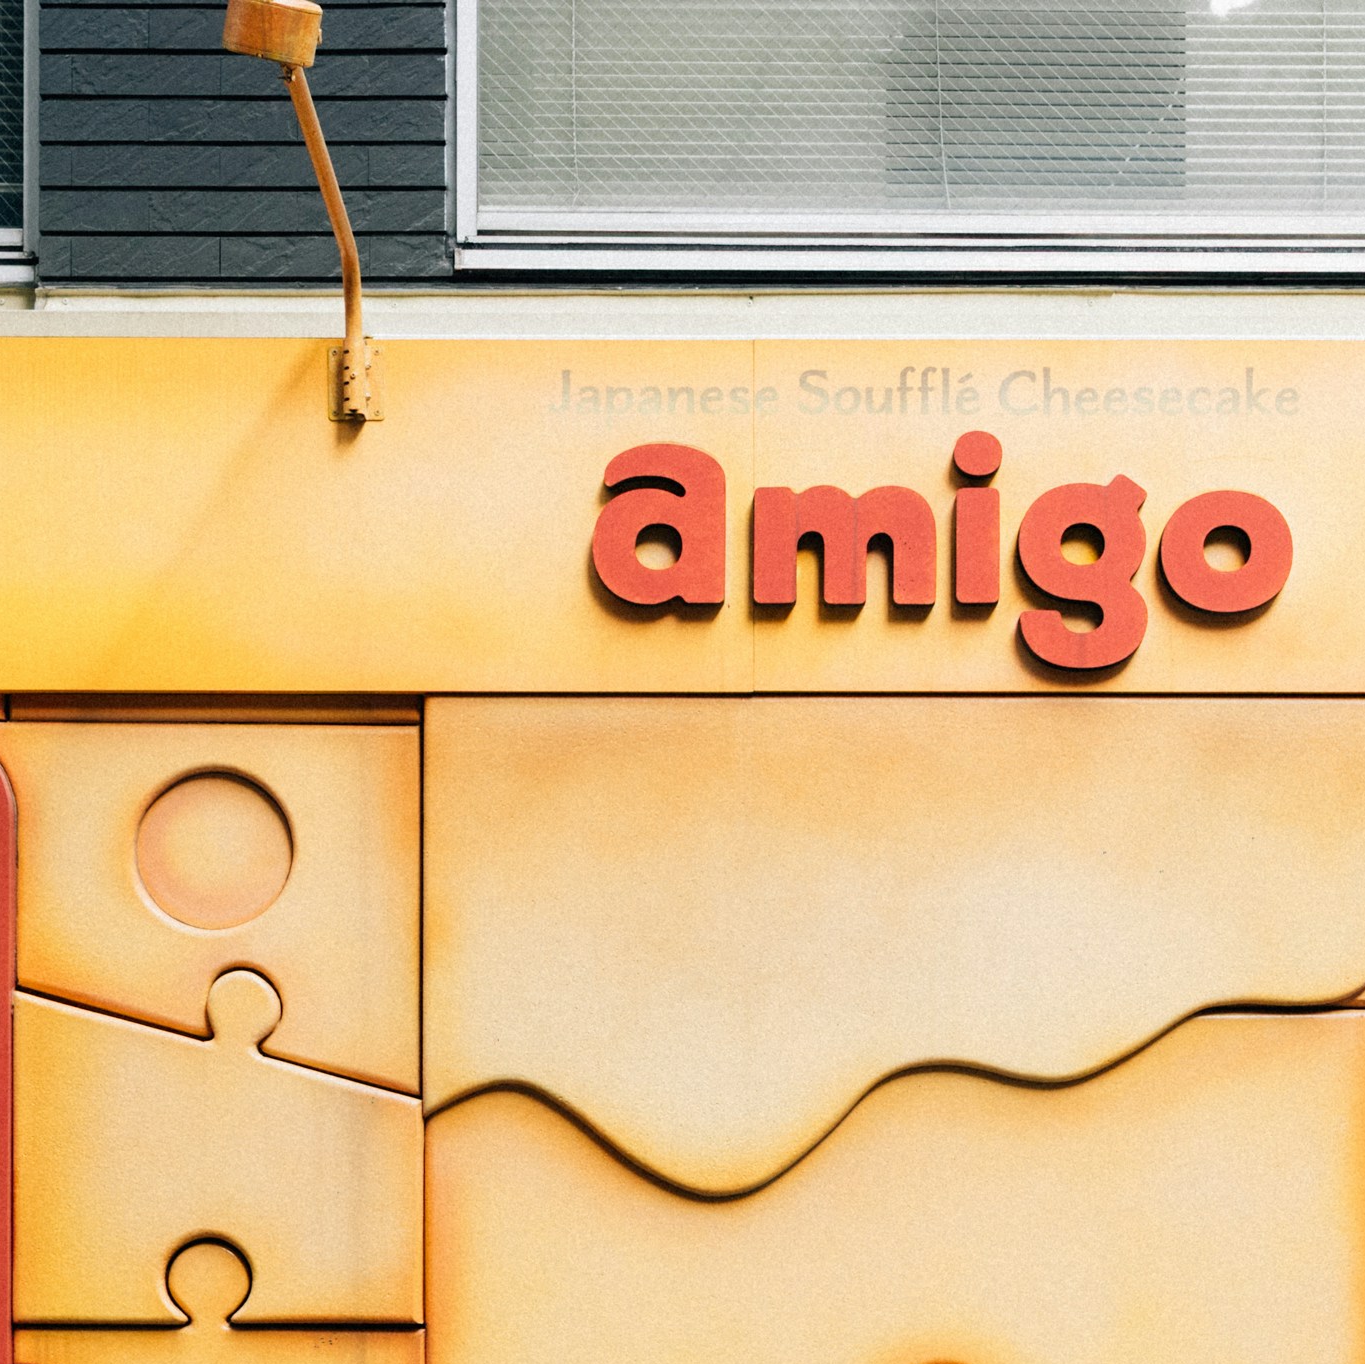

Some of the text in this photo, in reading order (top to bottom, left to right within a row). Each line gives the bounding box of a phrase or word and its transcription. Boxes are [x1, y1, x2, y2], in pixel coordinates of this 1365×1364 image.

[547, 365, 1301, 429] Japanese Soufflé Cheesecake
[591, 430, 1294, 671] amigo
